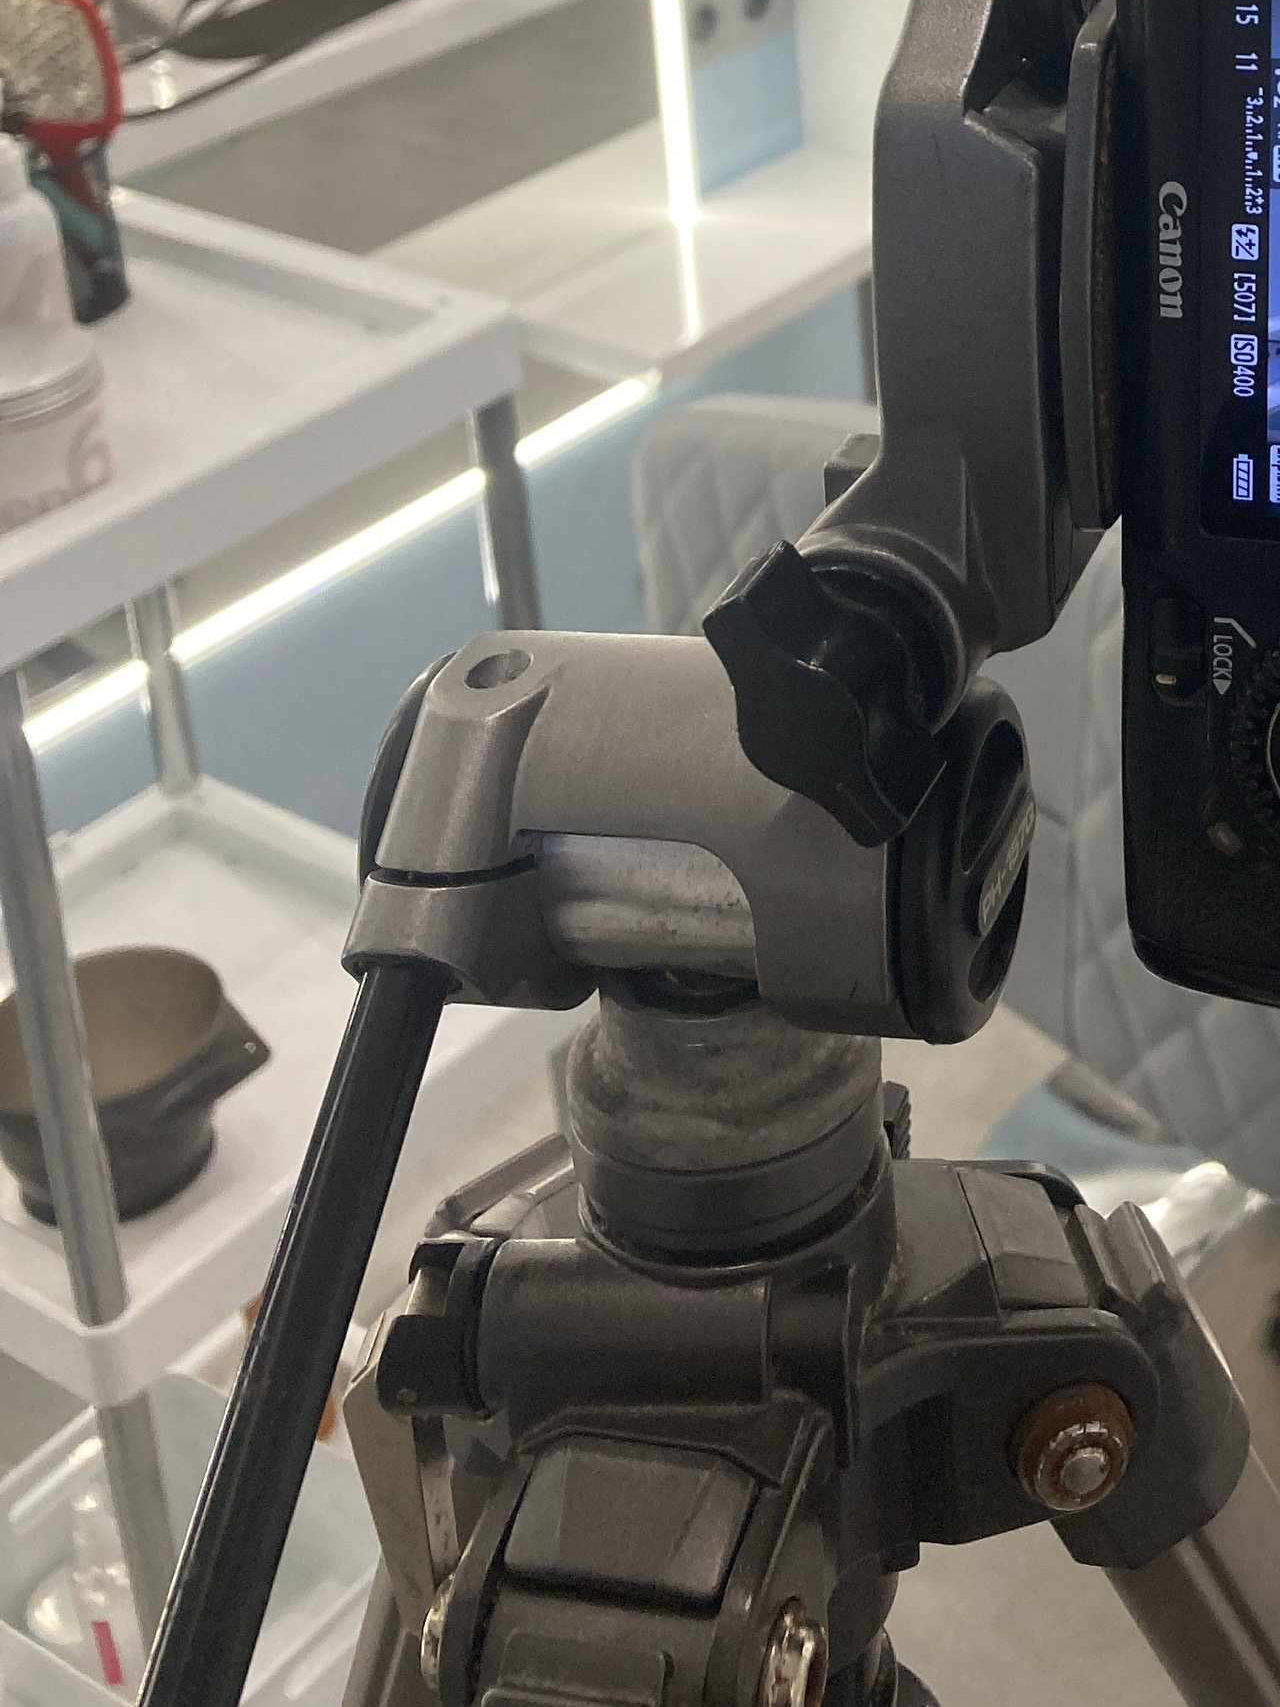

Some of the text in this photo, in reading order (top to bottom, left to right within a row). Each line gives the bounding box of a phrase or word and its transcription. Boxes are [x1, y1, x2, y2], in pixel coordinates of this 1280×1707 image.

[1235, 4, 1259, 25] 15
[1235, 52, 1259, 70] 11
[1158, 180, 1188, 319] Canon
[1213, 634, 1233, 679] LOCK
